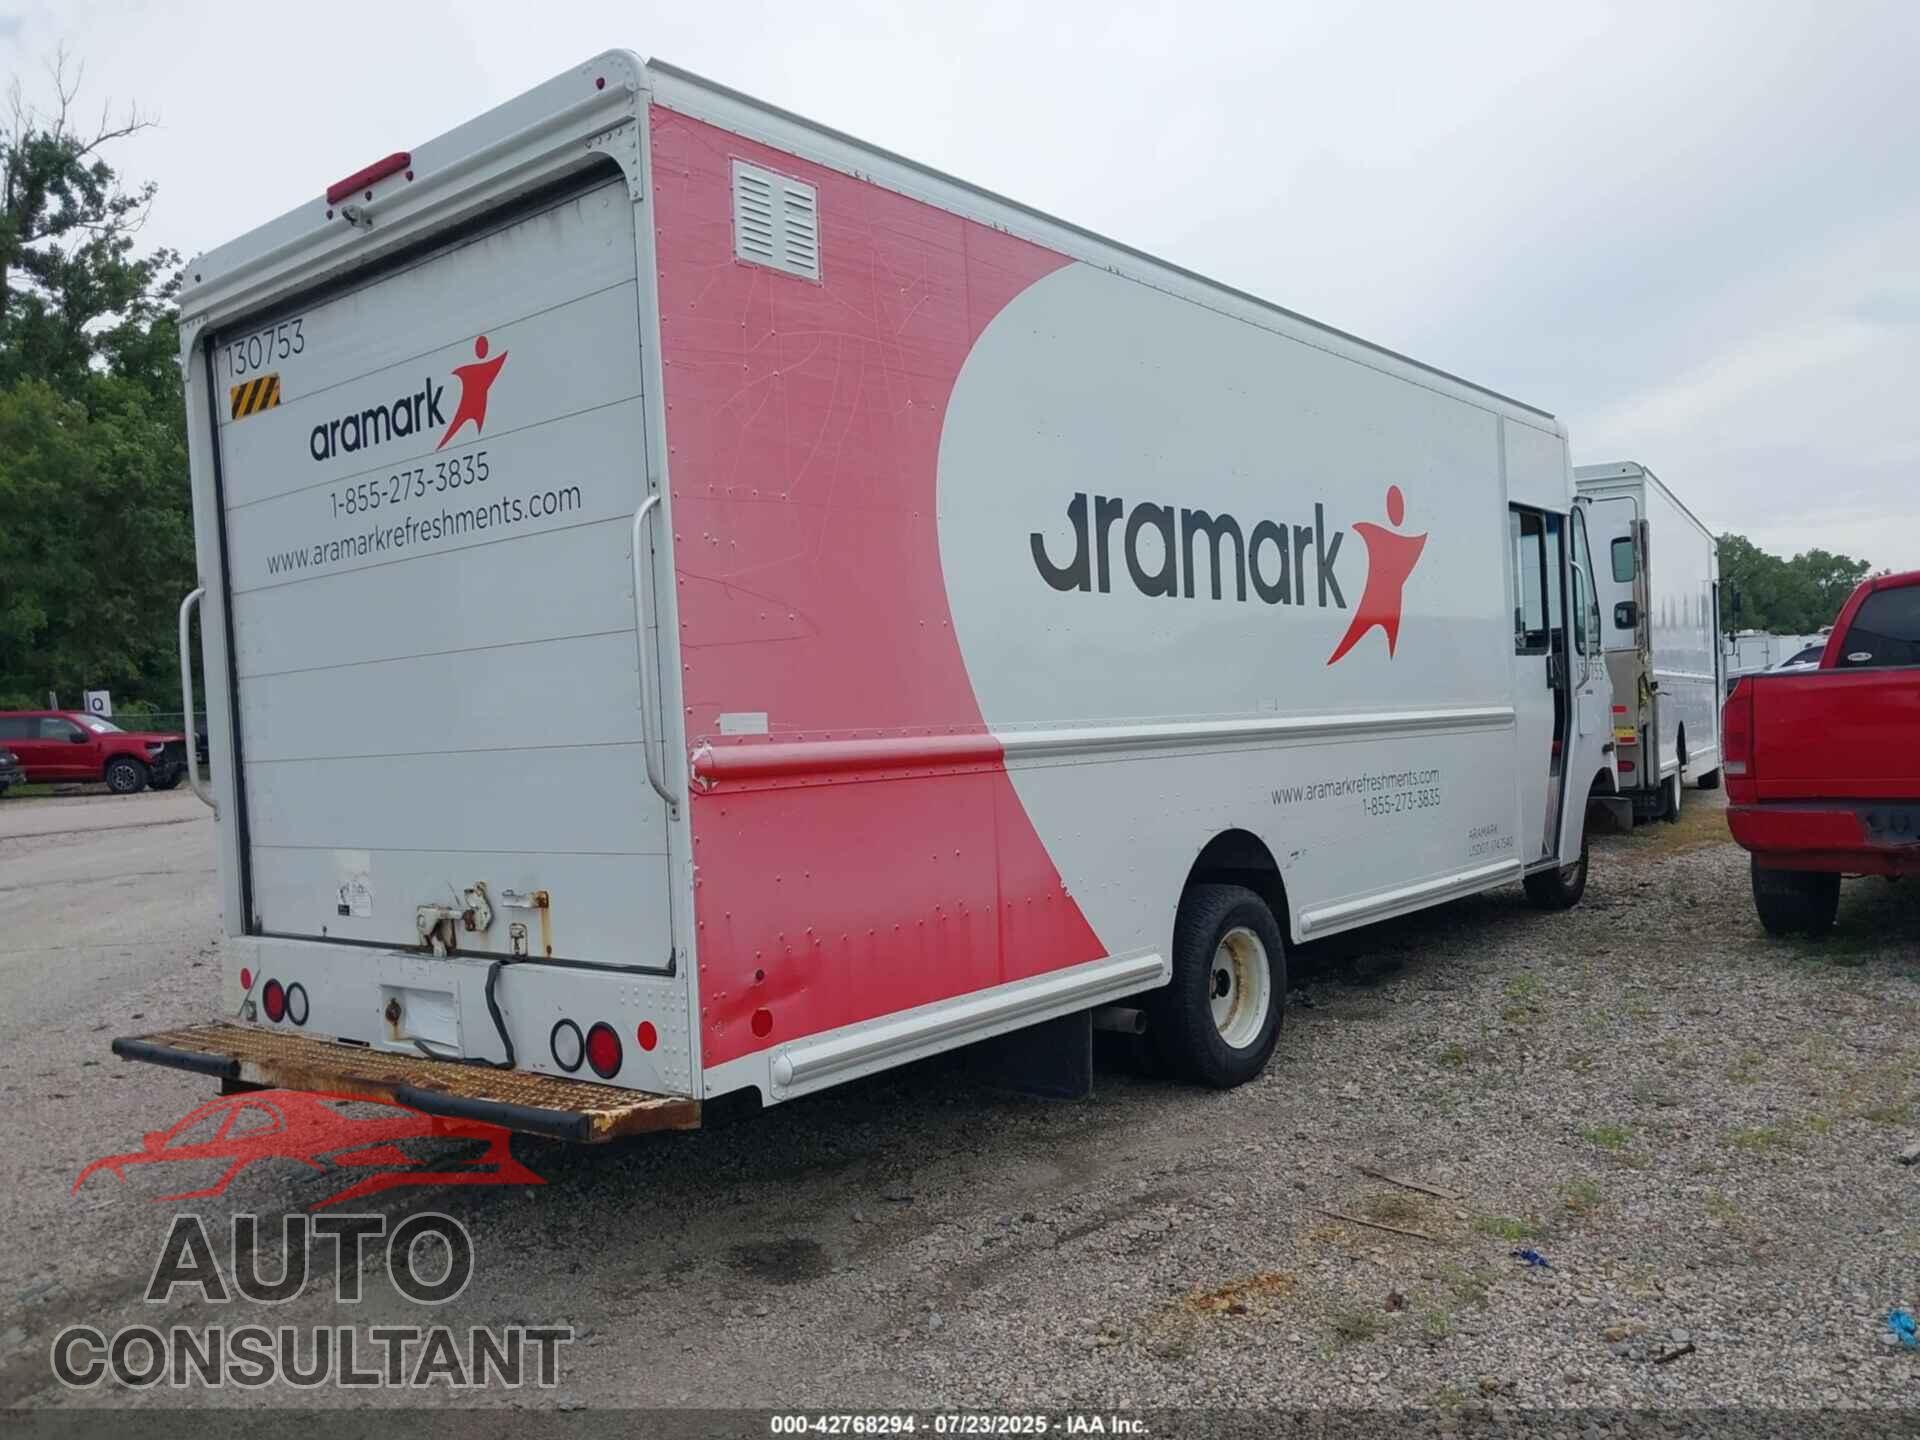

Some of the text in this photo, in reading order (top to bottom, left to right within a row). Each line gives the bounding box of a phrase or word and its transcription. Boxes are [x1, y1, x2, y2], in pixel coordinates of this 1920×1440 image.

[224, 319, 305, 377] 130753
[310, 378, 446, 461] aramark
[330, 452, 490, 518] 1-855-273-3835
[266, 485, 582, 575] www.aramarkrefreshments.com
[1030, 492, 1347, 609] aramark
[92, 697, 104, 711] Q
[1271, 769, 1440, 805] www.aramarkrefreshments.com
[1362, 788, 1441, 816] 1-855-273-3835
